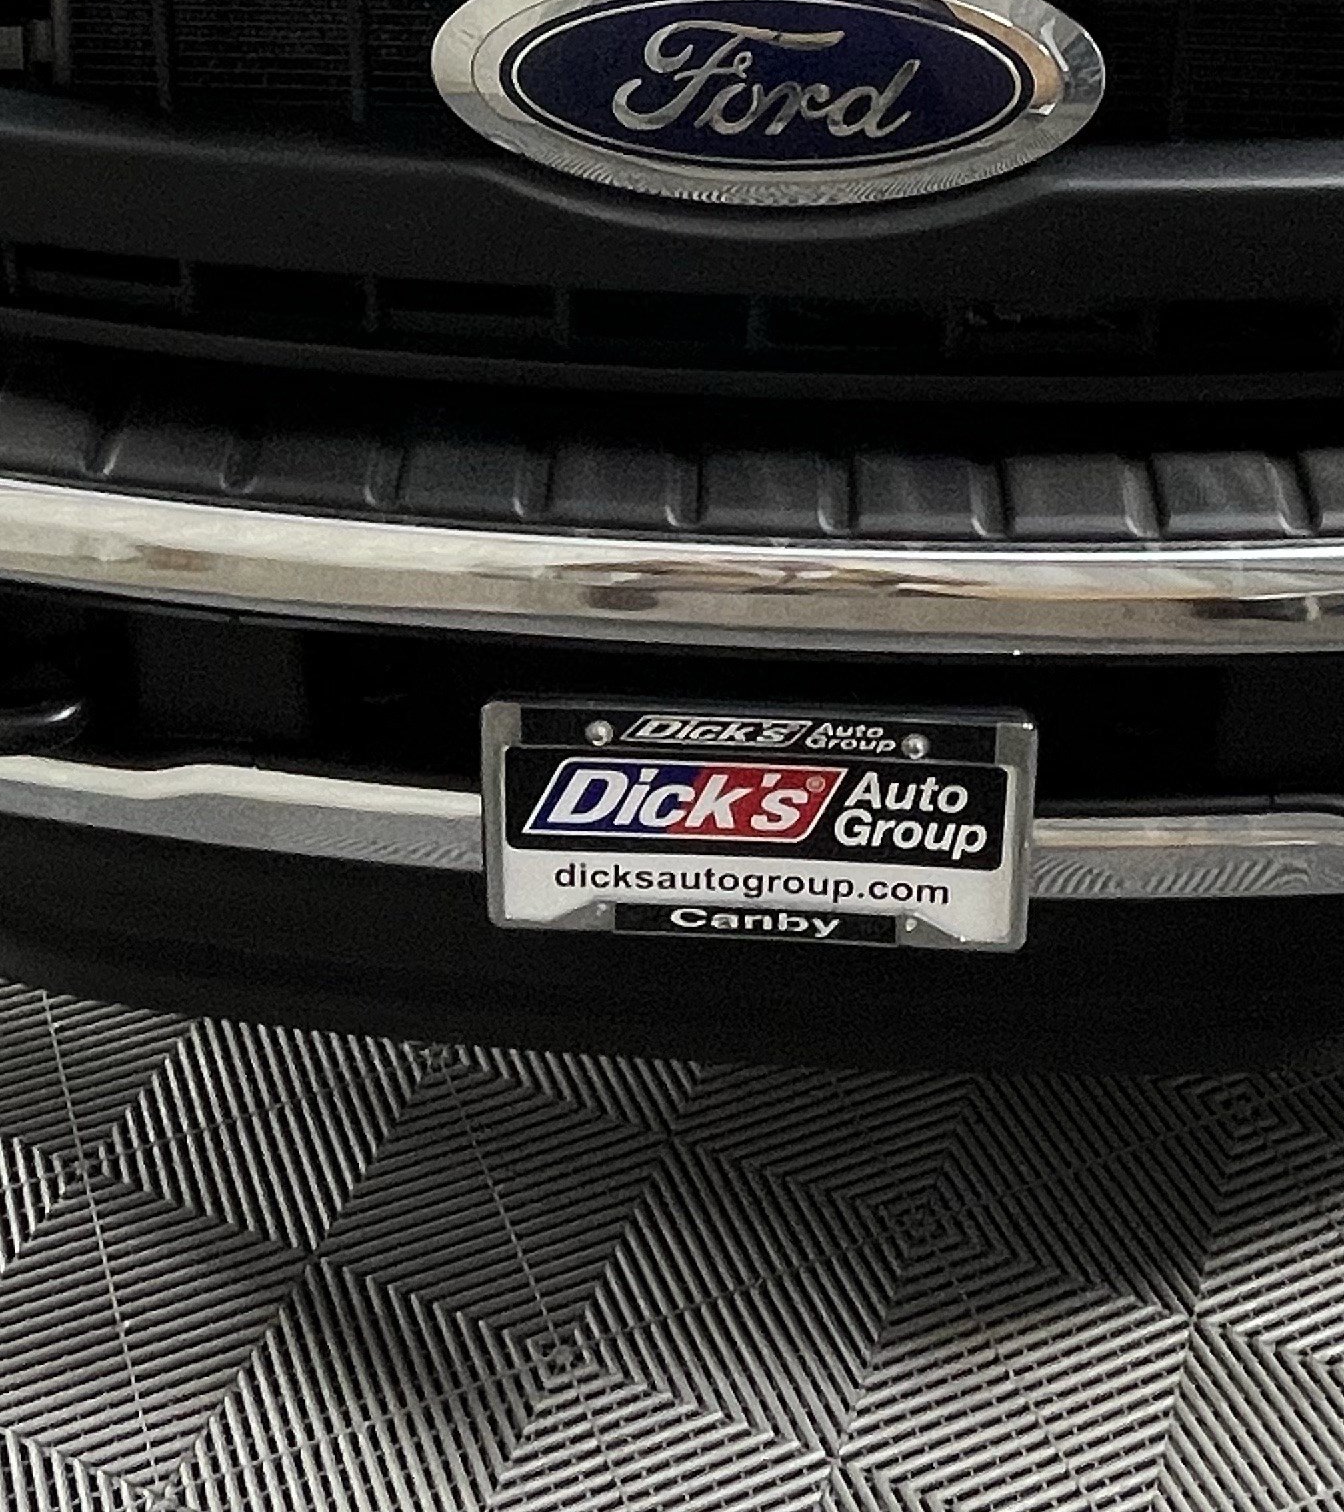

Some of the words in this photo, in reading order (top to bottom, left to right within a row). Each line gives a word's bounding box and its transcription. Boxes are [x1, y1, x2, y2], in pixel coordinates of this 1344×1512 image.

[611, 19, 921, 139] Ford
[805, 736, 897, 753] Group
[815, 722, 885, 738] Auto
[546, 767, 809, 832] Dick's
[843, 772, 969, 814] Auto
[834, 809, 988, 859] Group
[554, 863, 950, 905] dicksautogroup.com
[669, 907, 841, 937] Canby
